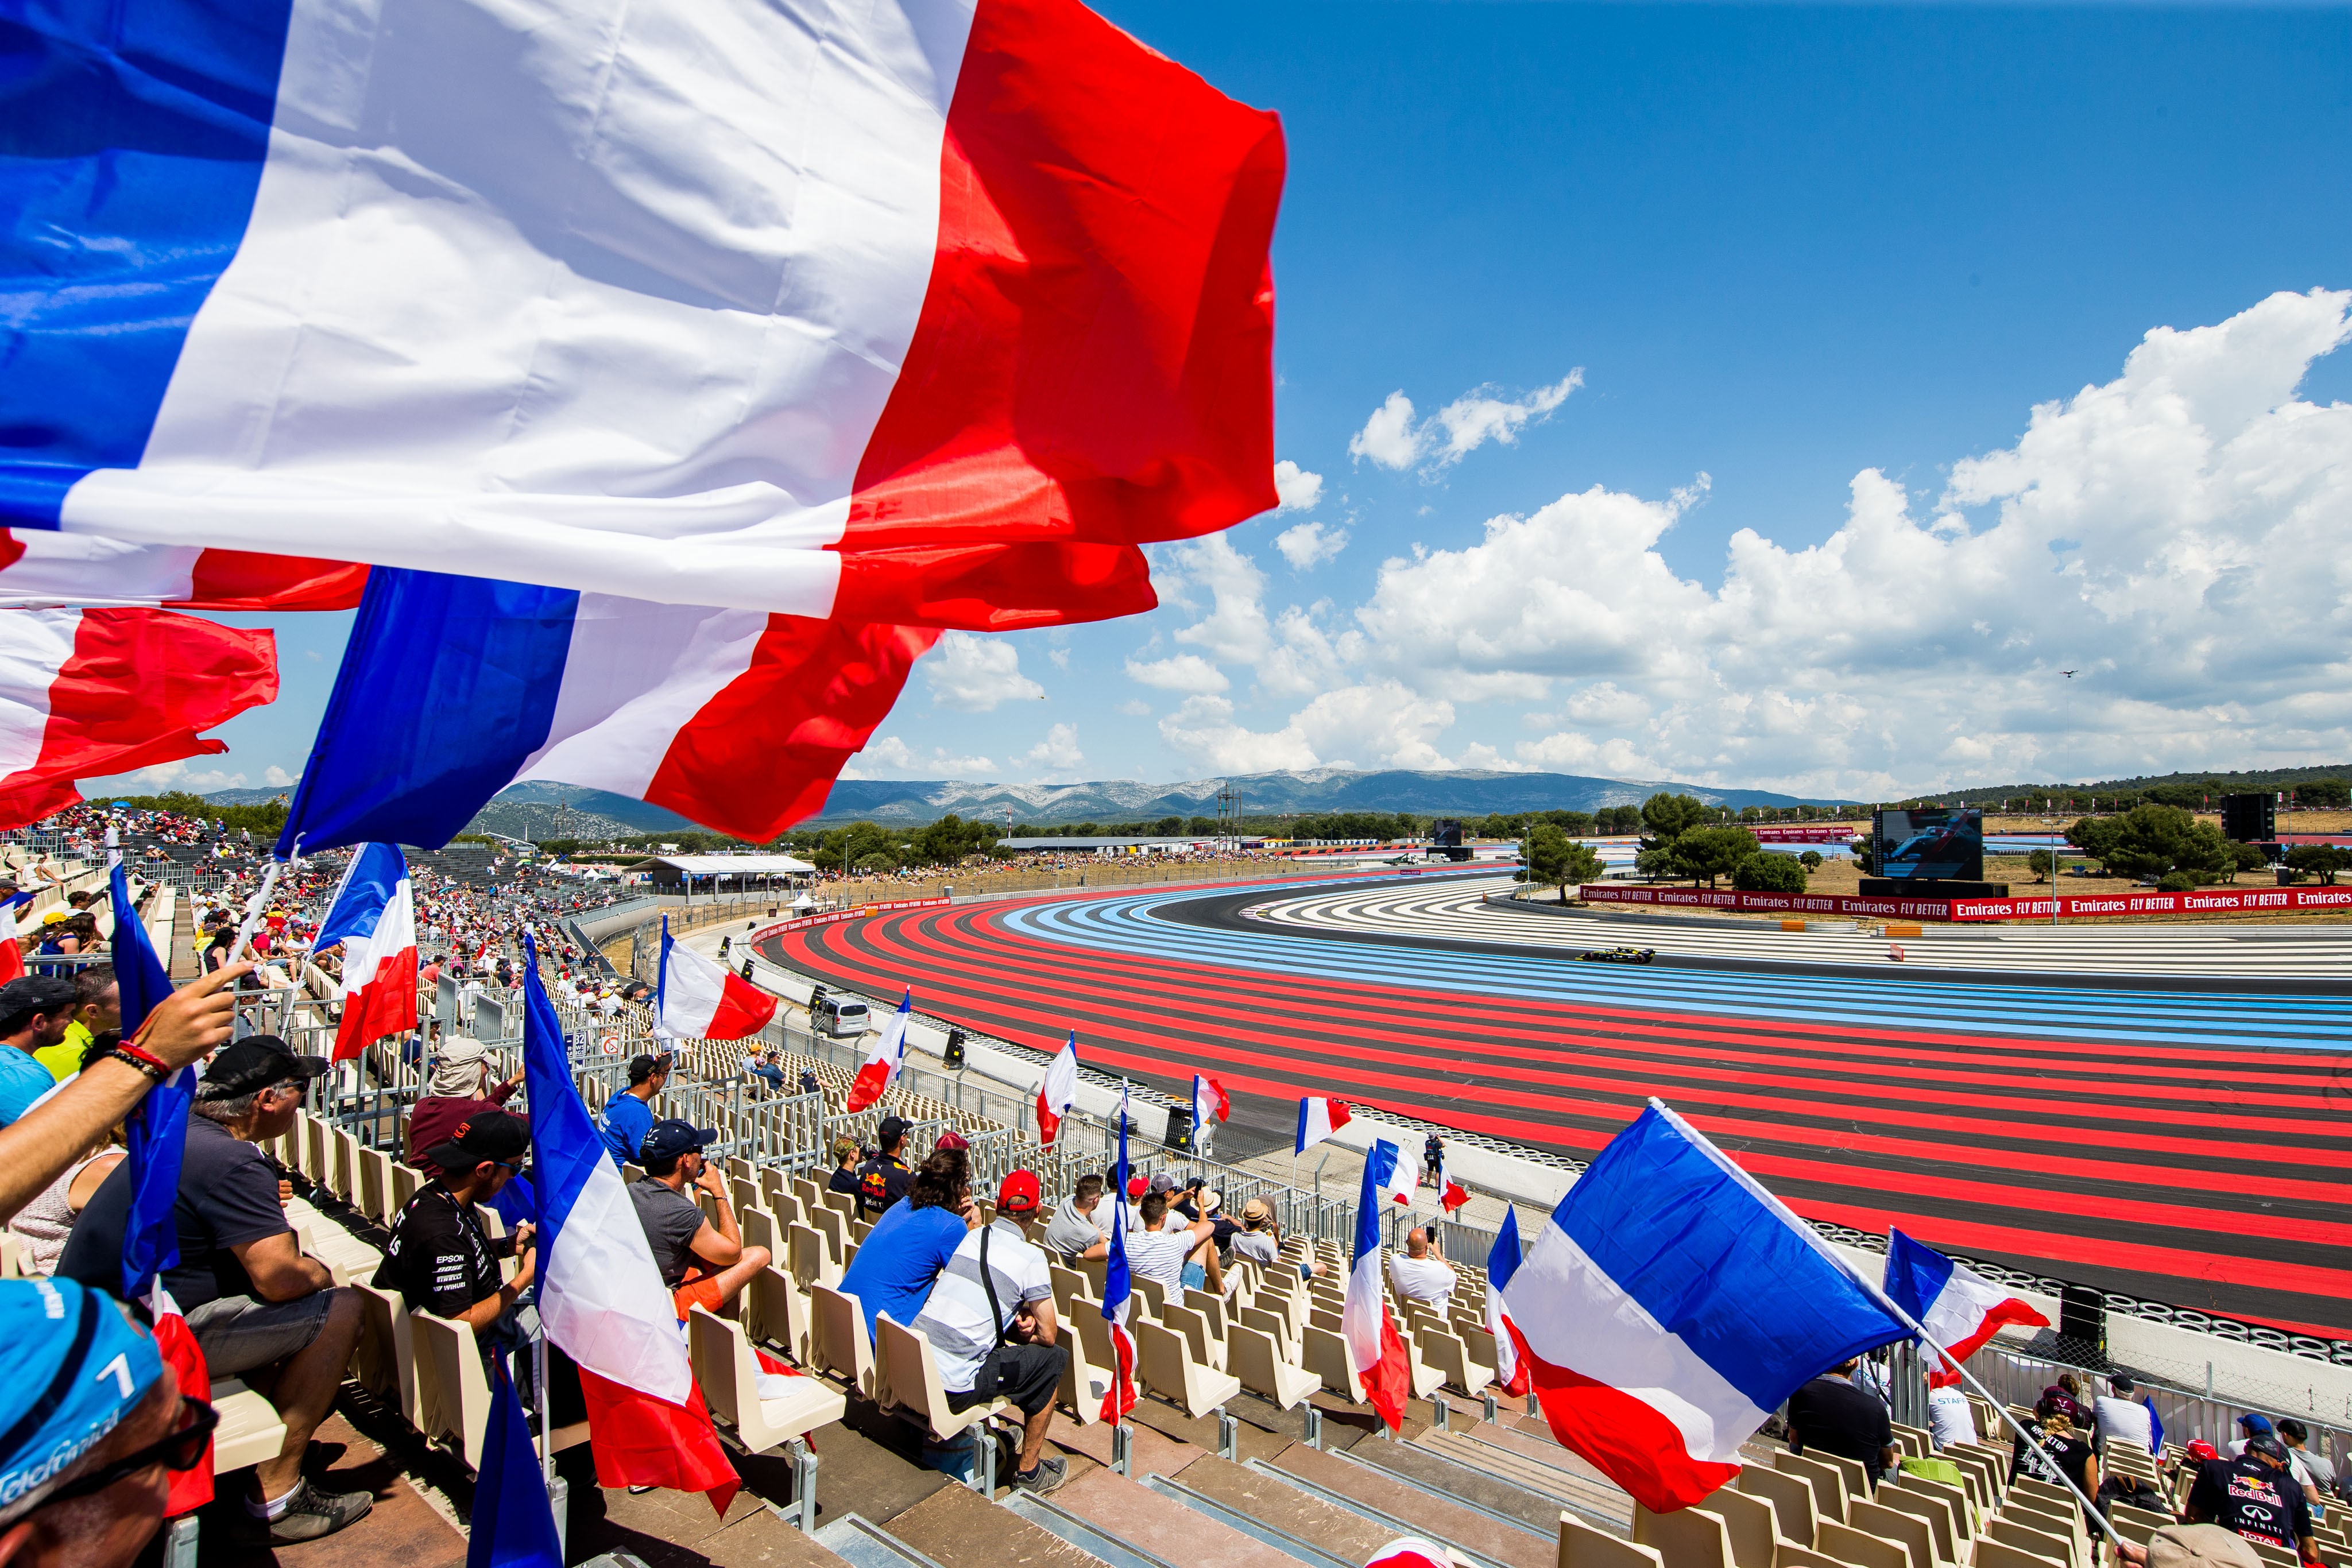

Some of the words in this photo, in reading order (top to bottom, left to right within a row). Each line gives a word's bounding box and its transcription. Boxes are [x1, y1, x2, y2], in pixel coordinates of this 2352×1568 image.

[1583, 889, 1619, 899] Emirates
[1622, 891, 1632, 900] FLY
[1632, 891, 1652, 901] BETTER
[1658, 892, 1698, 903] Emirates
[1701, 893, 1712, 904] FLY
[1713, 895, 1736, 905] BETTER
[2183, 896, 2239, 909] Emirates
[2243, 895, 2257, 906] FLY
[2258, 893, 2287, 905] BETTER
[2297, 892, 2352, 904] Emirates
[1743, 896, 1789, 908] Emirates
[1793, 898, 1805, 909] FLY
[1806, 899, 1833, 910] BETTER
[1842, 900, 1895, 913] Emirates
[1900, 903, 1914, 914] FLY
[1916, 904, 1947, 917] BETTER
[1956, 903, 2011, 916] Emirates
[2016, 902, 2030, 914] FLY
[2071, 900, 2126, 912] Emirates
[2130, 899, 2144, 910] FLY
[2145, 897, 2174, 909] BETTER
[862, 1183, 873, 1194] Red
[873, 1187, 886, 1198] Bull
[436, 1255, 464, 1264] EPSON
[432, 1264, 466, 1273] BOSE
[437, 1273, 462, 1283] PIRELLI
[444, 1281, 466, 1291] WIHURI
[2228, 1484, 2256, 1500] Red
[2256, 1490, 2283, 1507] Bull
[2235, 1517, 2283, 1534] INFINITI
[2241, 1530, 2279, 1547] TOTAL
